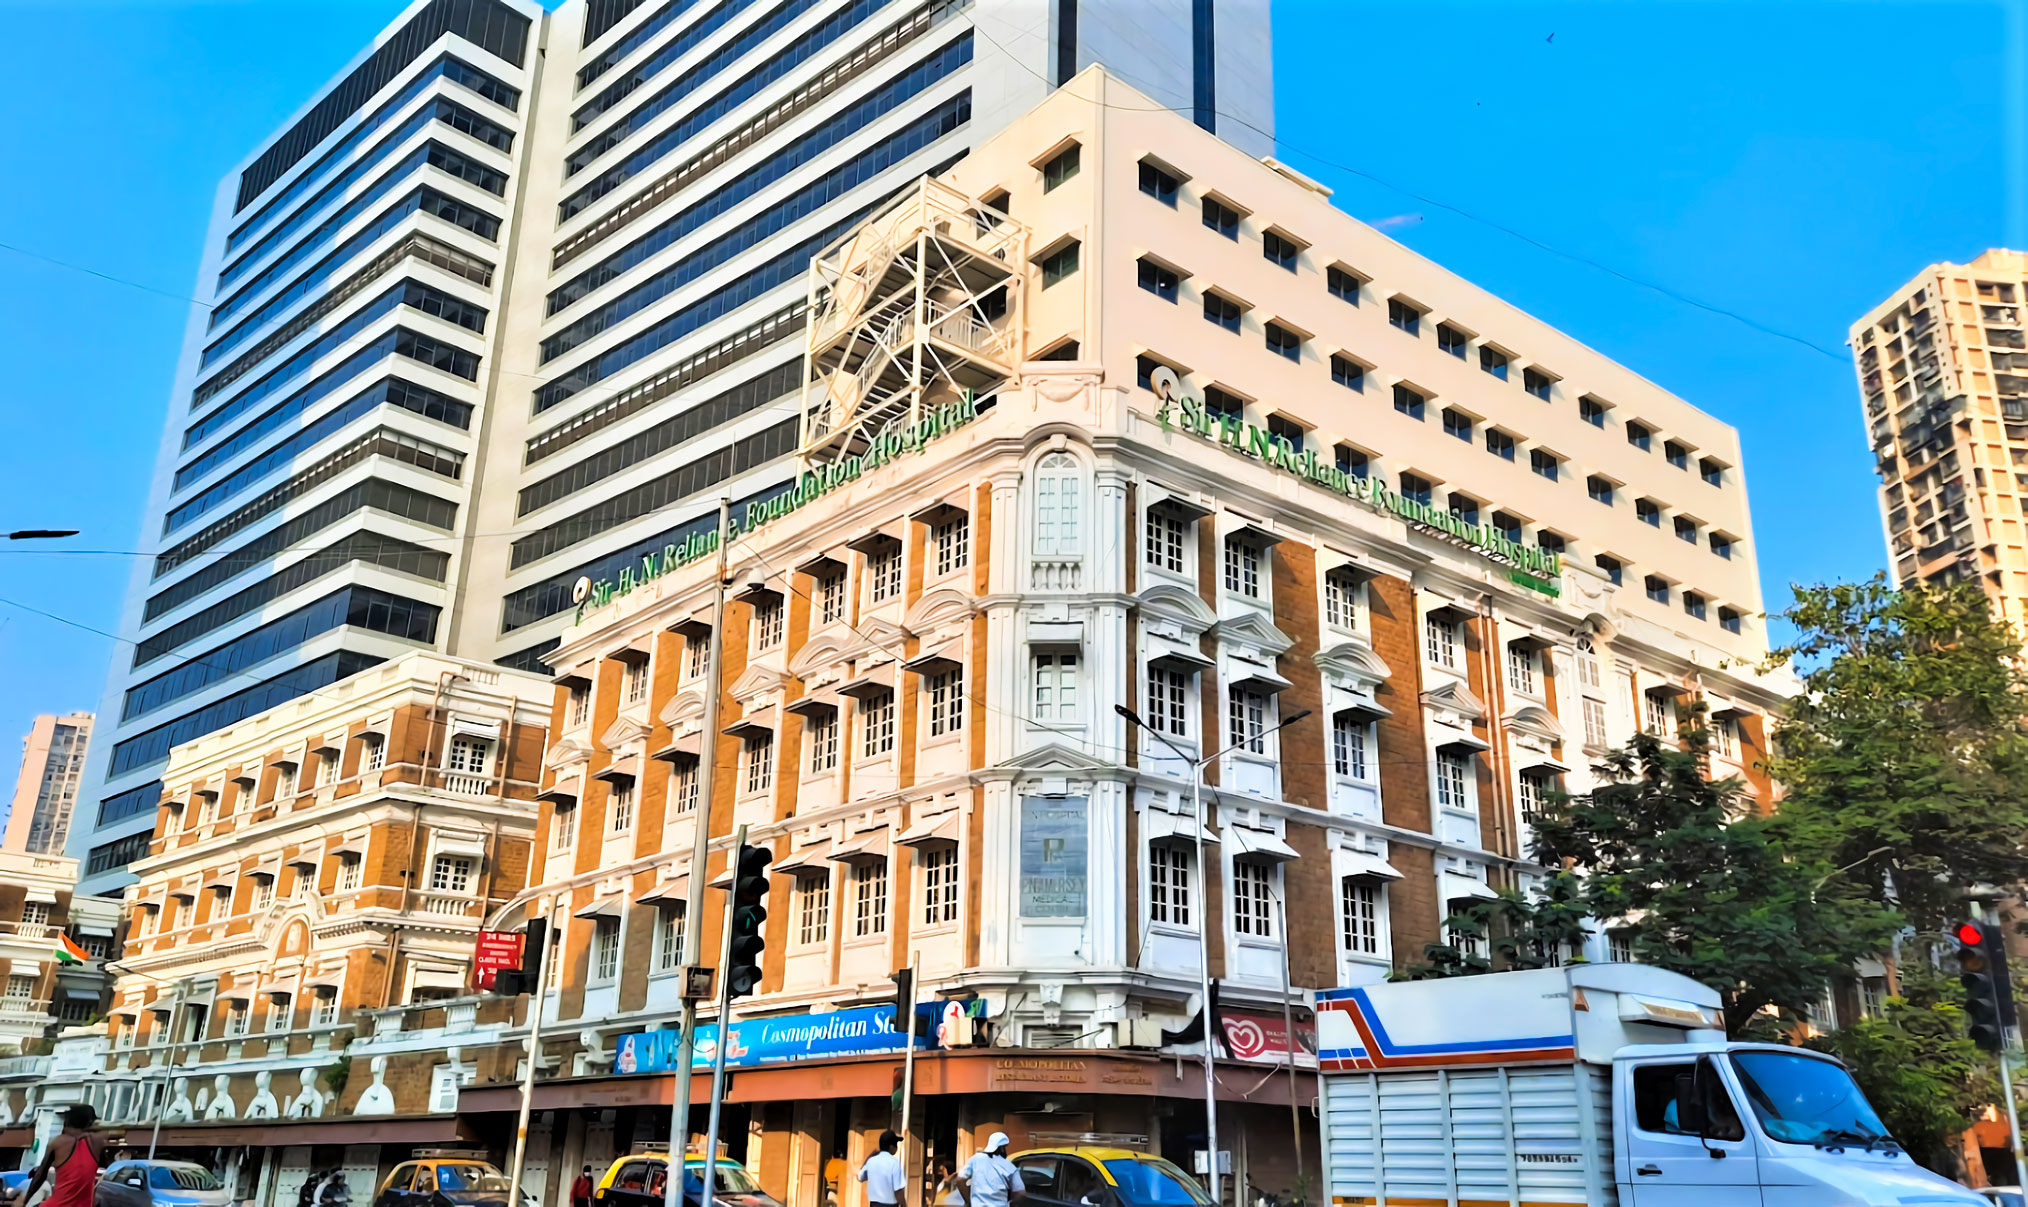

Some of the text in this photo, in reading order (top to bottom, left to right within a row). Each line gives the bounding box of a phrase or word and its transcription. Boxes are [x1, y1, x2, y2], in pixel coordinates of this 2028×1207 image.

[590, 578, 613, 607] Sir
[662, 517, 741, 575] Reliane
[743, 455, 862, 534] Foundation
[871, 387, 975, 470] Hospital
[1179, 396, 1218, 438] Sir
[1275, 432, 1370, 500] Reliance
[1371, 476, 1483, 545] Foundation
[1482, 523, 1561, 578] Hospital
[761, 1015, 867, 1050] Cosmopolitan
